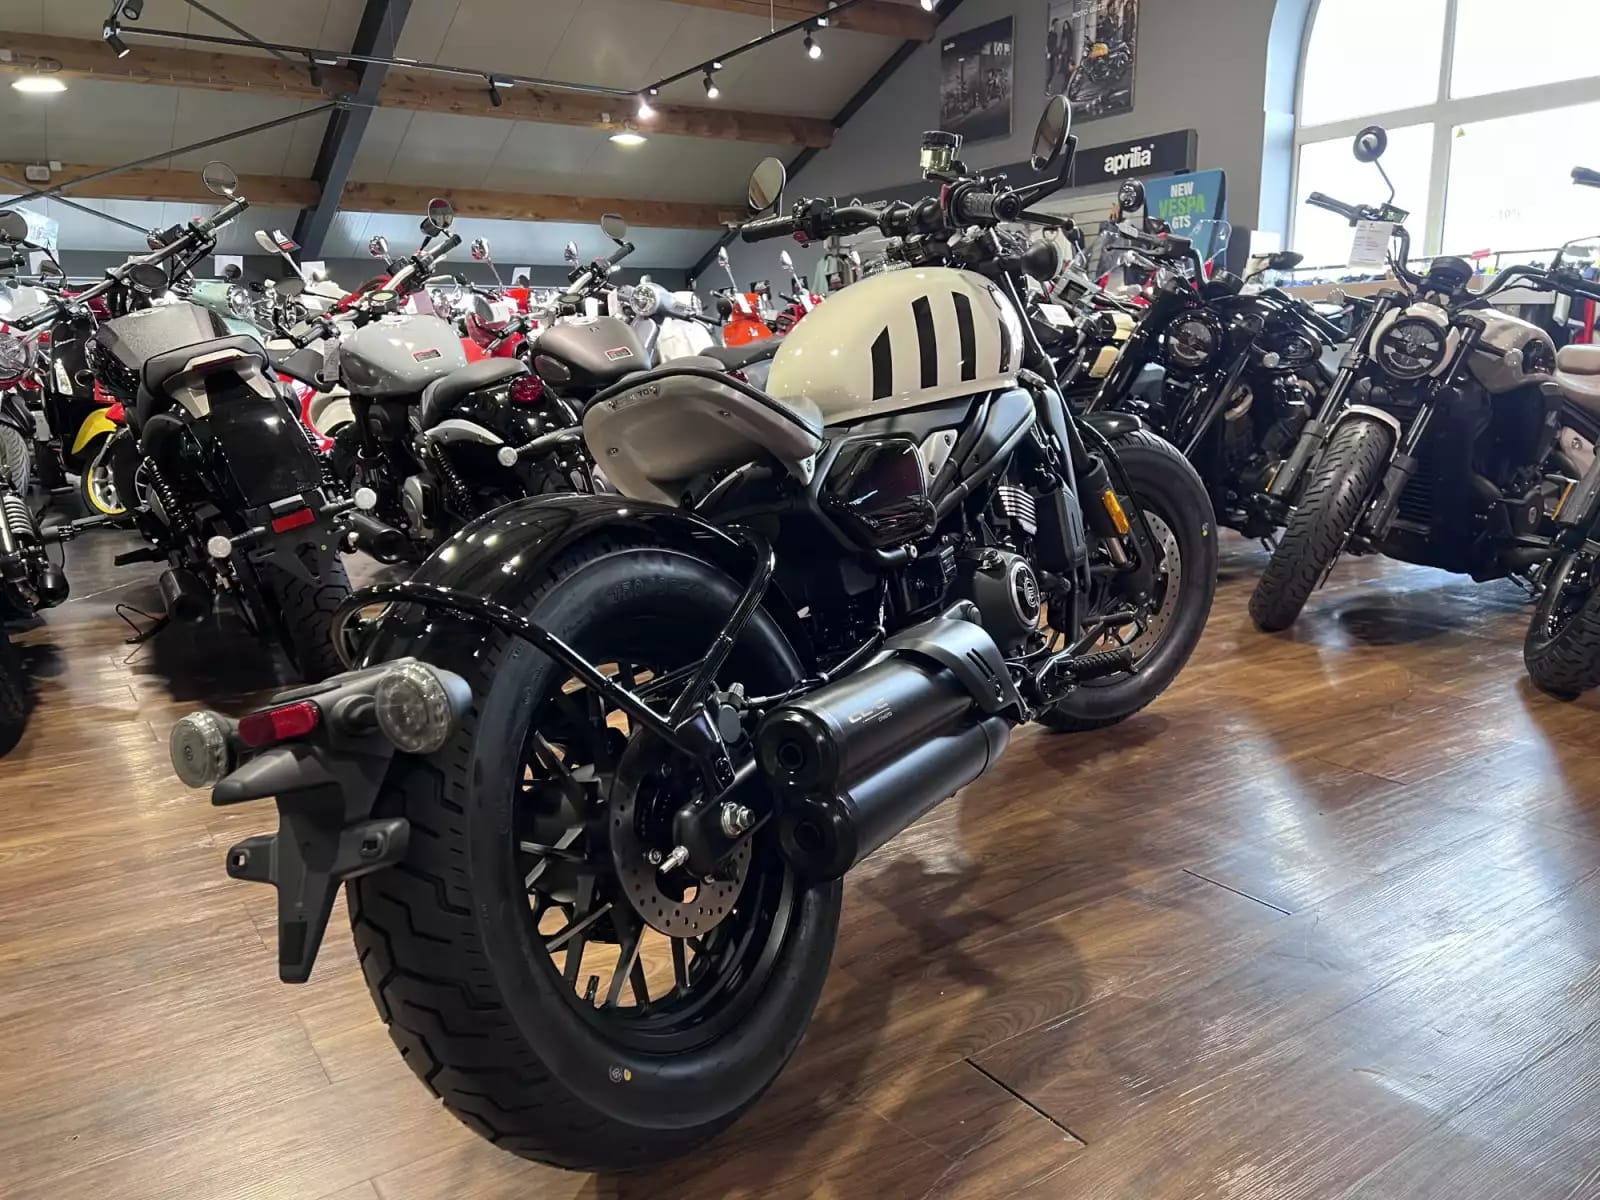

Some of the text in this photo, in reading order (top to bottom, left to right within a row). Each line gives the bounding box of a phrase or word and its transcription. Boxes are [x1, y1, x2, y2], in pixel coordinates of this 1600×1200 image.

[1103, 146, 1152, 175] aprilia
[1170, 181, 1194, 198] NEW
[1159, 193, 1206, 218] VESPA
[1171, 215, 1191, 230] GTS
